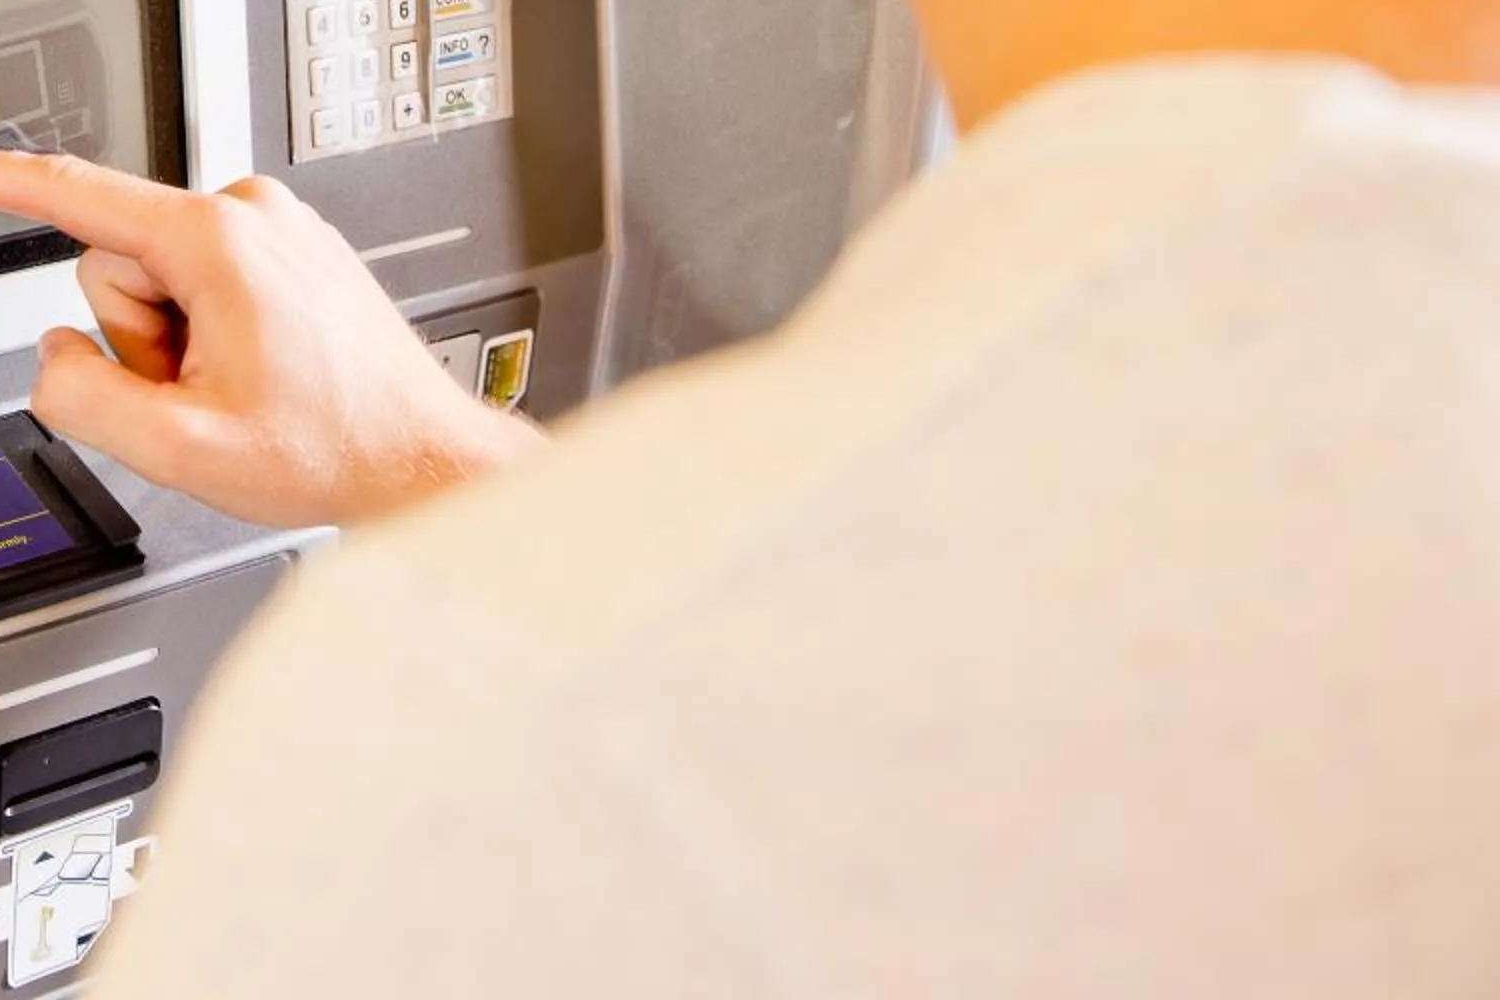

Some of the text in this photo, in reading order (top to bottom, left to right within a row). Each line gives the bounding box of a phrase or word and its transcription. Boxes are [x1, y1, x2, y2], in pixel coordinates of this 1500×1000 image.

[316, 15, 328, 33] 4
[399, 0, 410, 20] 6
[360, 57, 372, 78] 8
[401, 51, 412, 70] 9
[438, 37, 470, 56] INFO
[477, 34, 490, 56] ?
[363, 109, 375, 129] 0
[444, 86, 468, 106] OK
